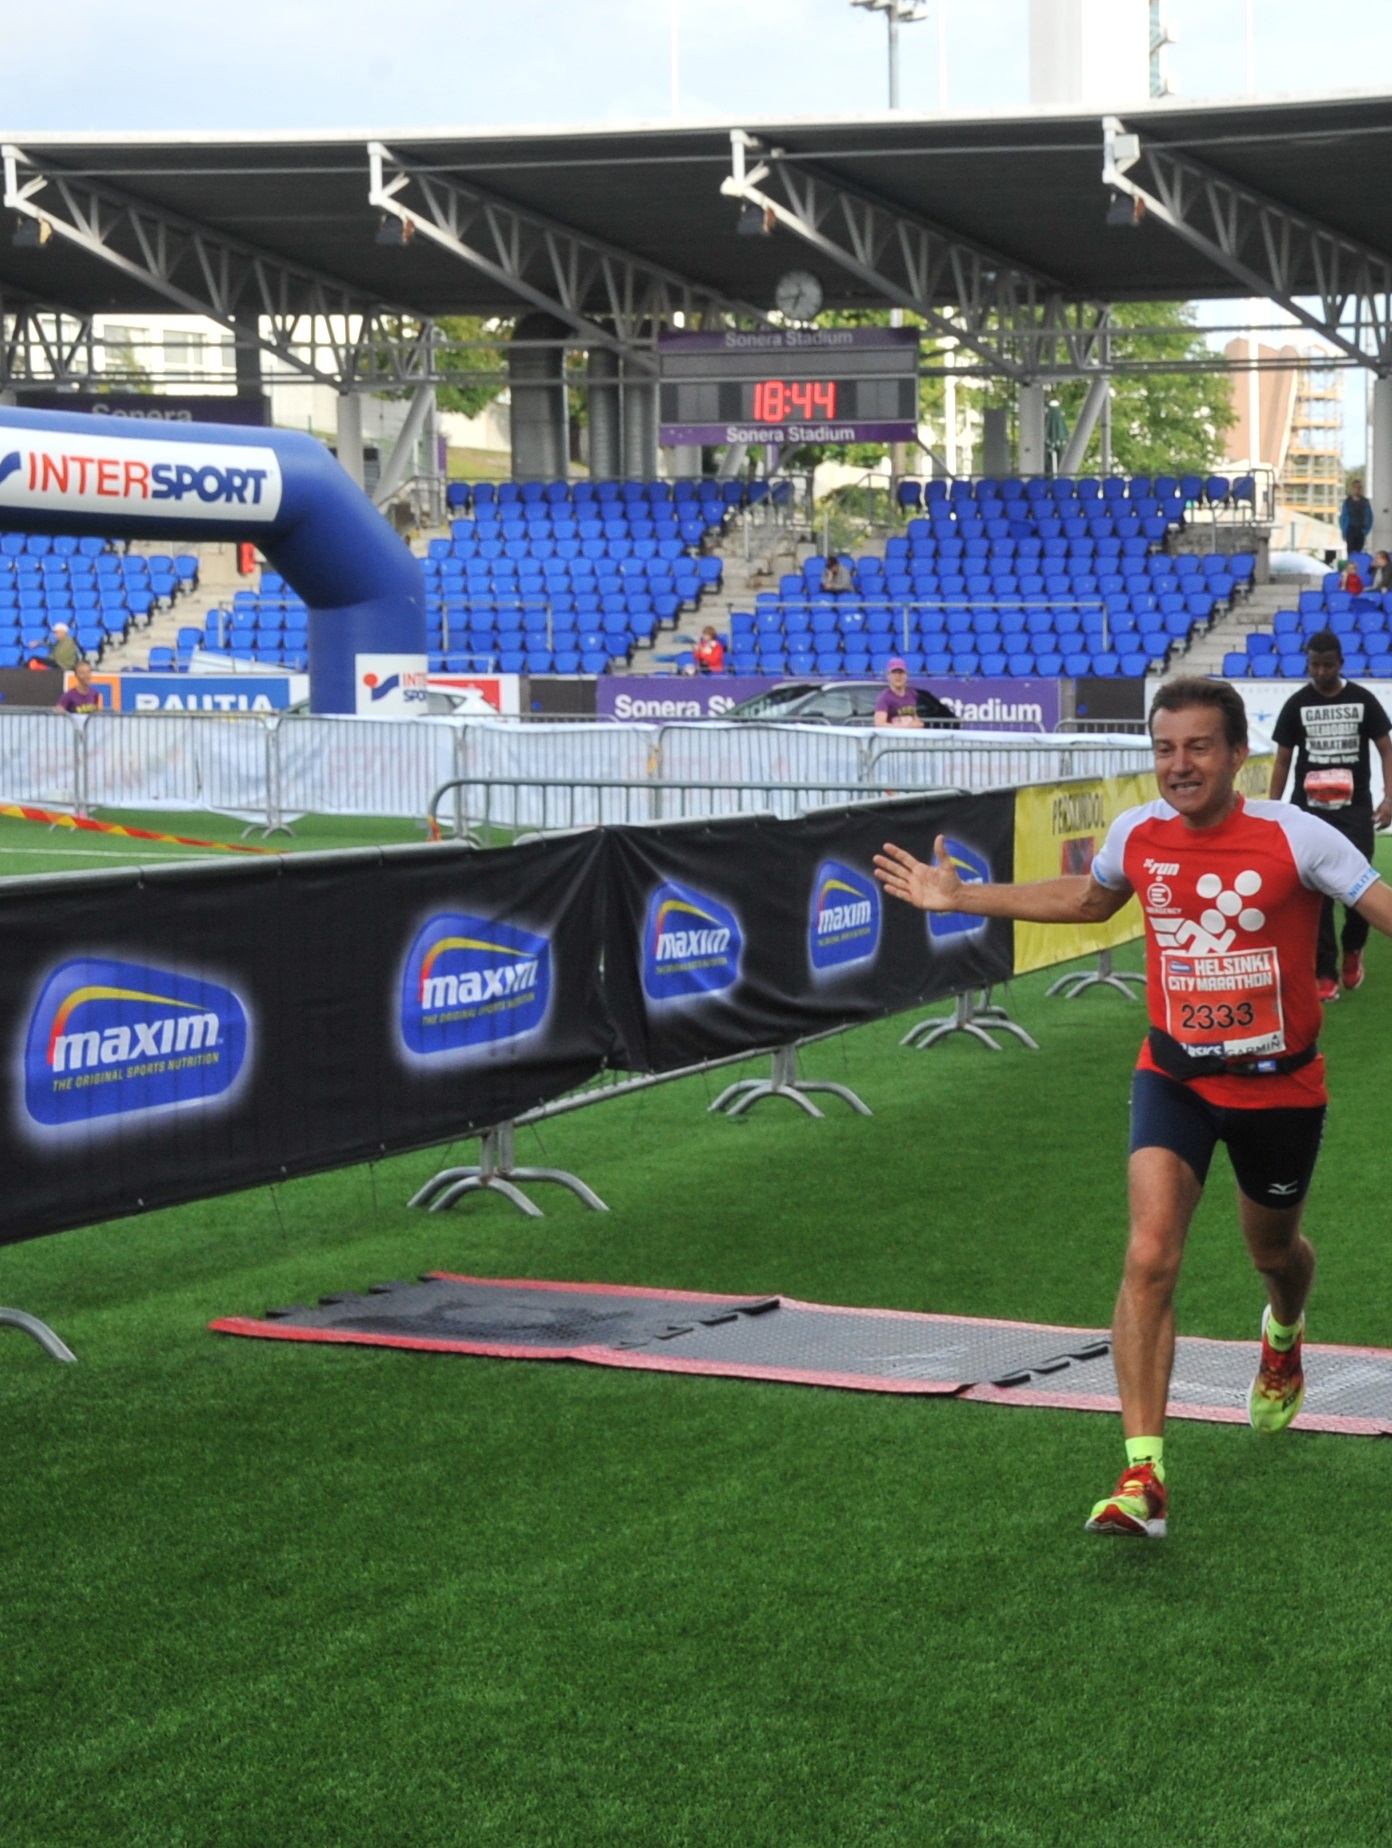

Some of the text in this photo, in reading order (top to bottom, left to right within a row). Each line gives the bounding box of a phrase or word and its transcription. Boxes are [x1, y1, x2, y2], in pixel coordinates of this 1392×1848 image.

[725, 331, 853, 348] Sonera Stadium
[754, 380, 836, 422] 18:44
[726, 426, 855, 443] Sonera Stadium
[29, 452, 268, 504] INTERSPORT
[614, 694, 701, 718] Sonera
[1305, 707, 1359, 722] GARISSA
[818, 900, 871, 935] maxim
[656, 928, 730, 961] maxim
[1194, 954, 1271, 976] HELSINKI
[421, 960, 538, 1010] maxim
[1168, 971, 1273, 992] CITY MARATHON
[1181, 1002, 1254, 1030] 2333
[53, 1012, 219, 1073] maxim
[53, 1052, 219, 1092] THE ORIGINAL SPORTS NUTRITION
